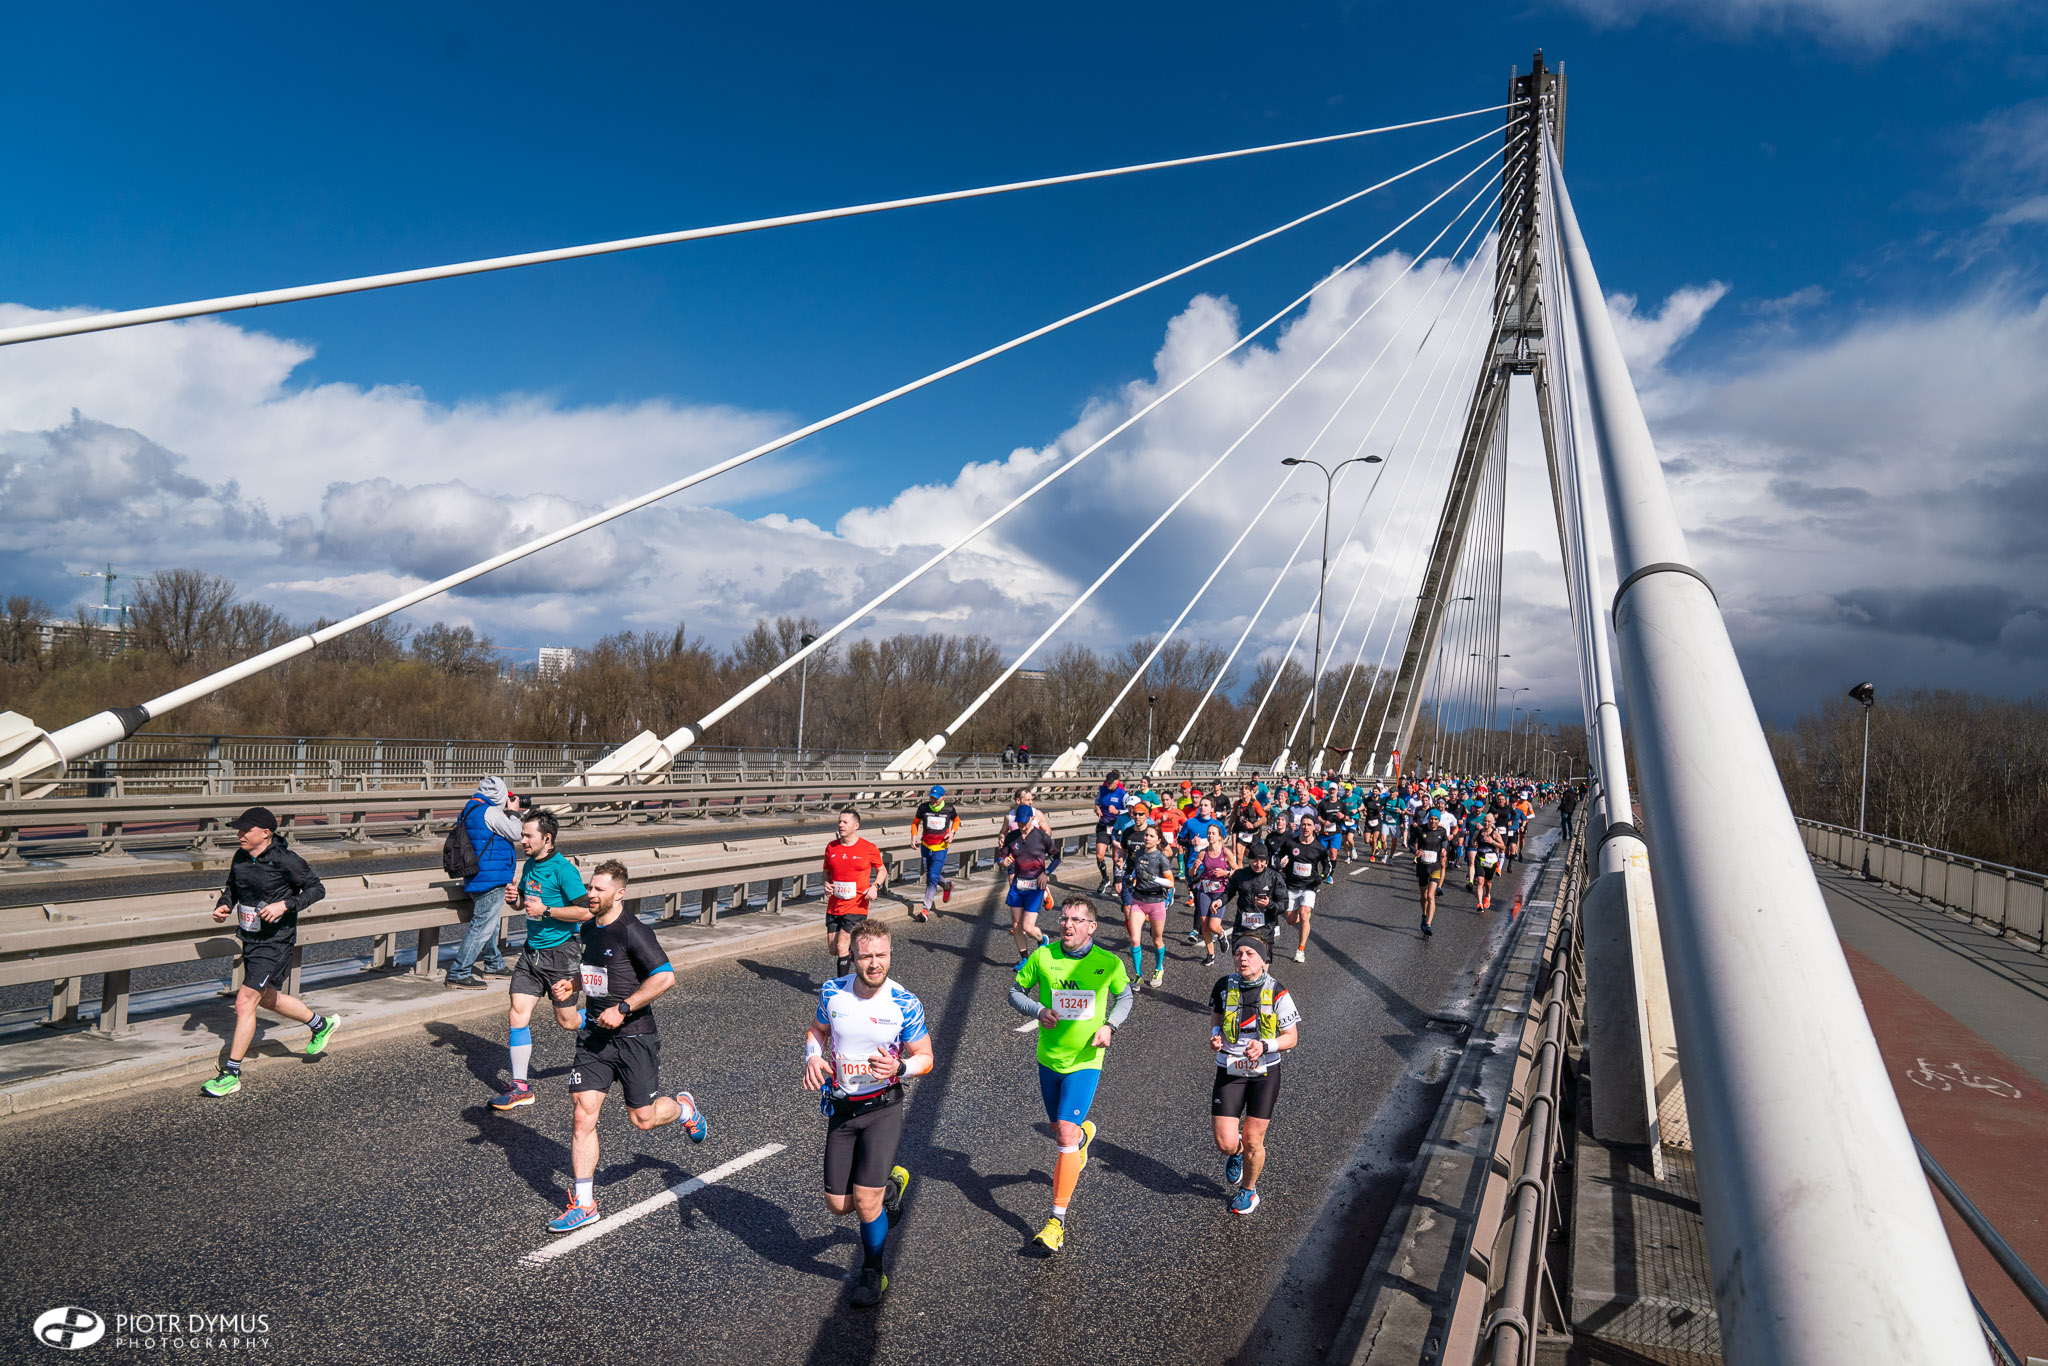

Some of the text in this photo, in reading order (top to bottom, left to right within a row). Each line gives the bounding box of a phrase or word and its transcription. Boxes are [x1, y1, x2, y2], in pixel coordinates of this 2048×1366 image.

[1245, 916, 1261, 924] 13843
[1059, 998, 1088, 1009] 13241
[1234, 1060, 1260, 1070] 10122
